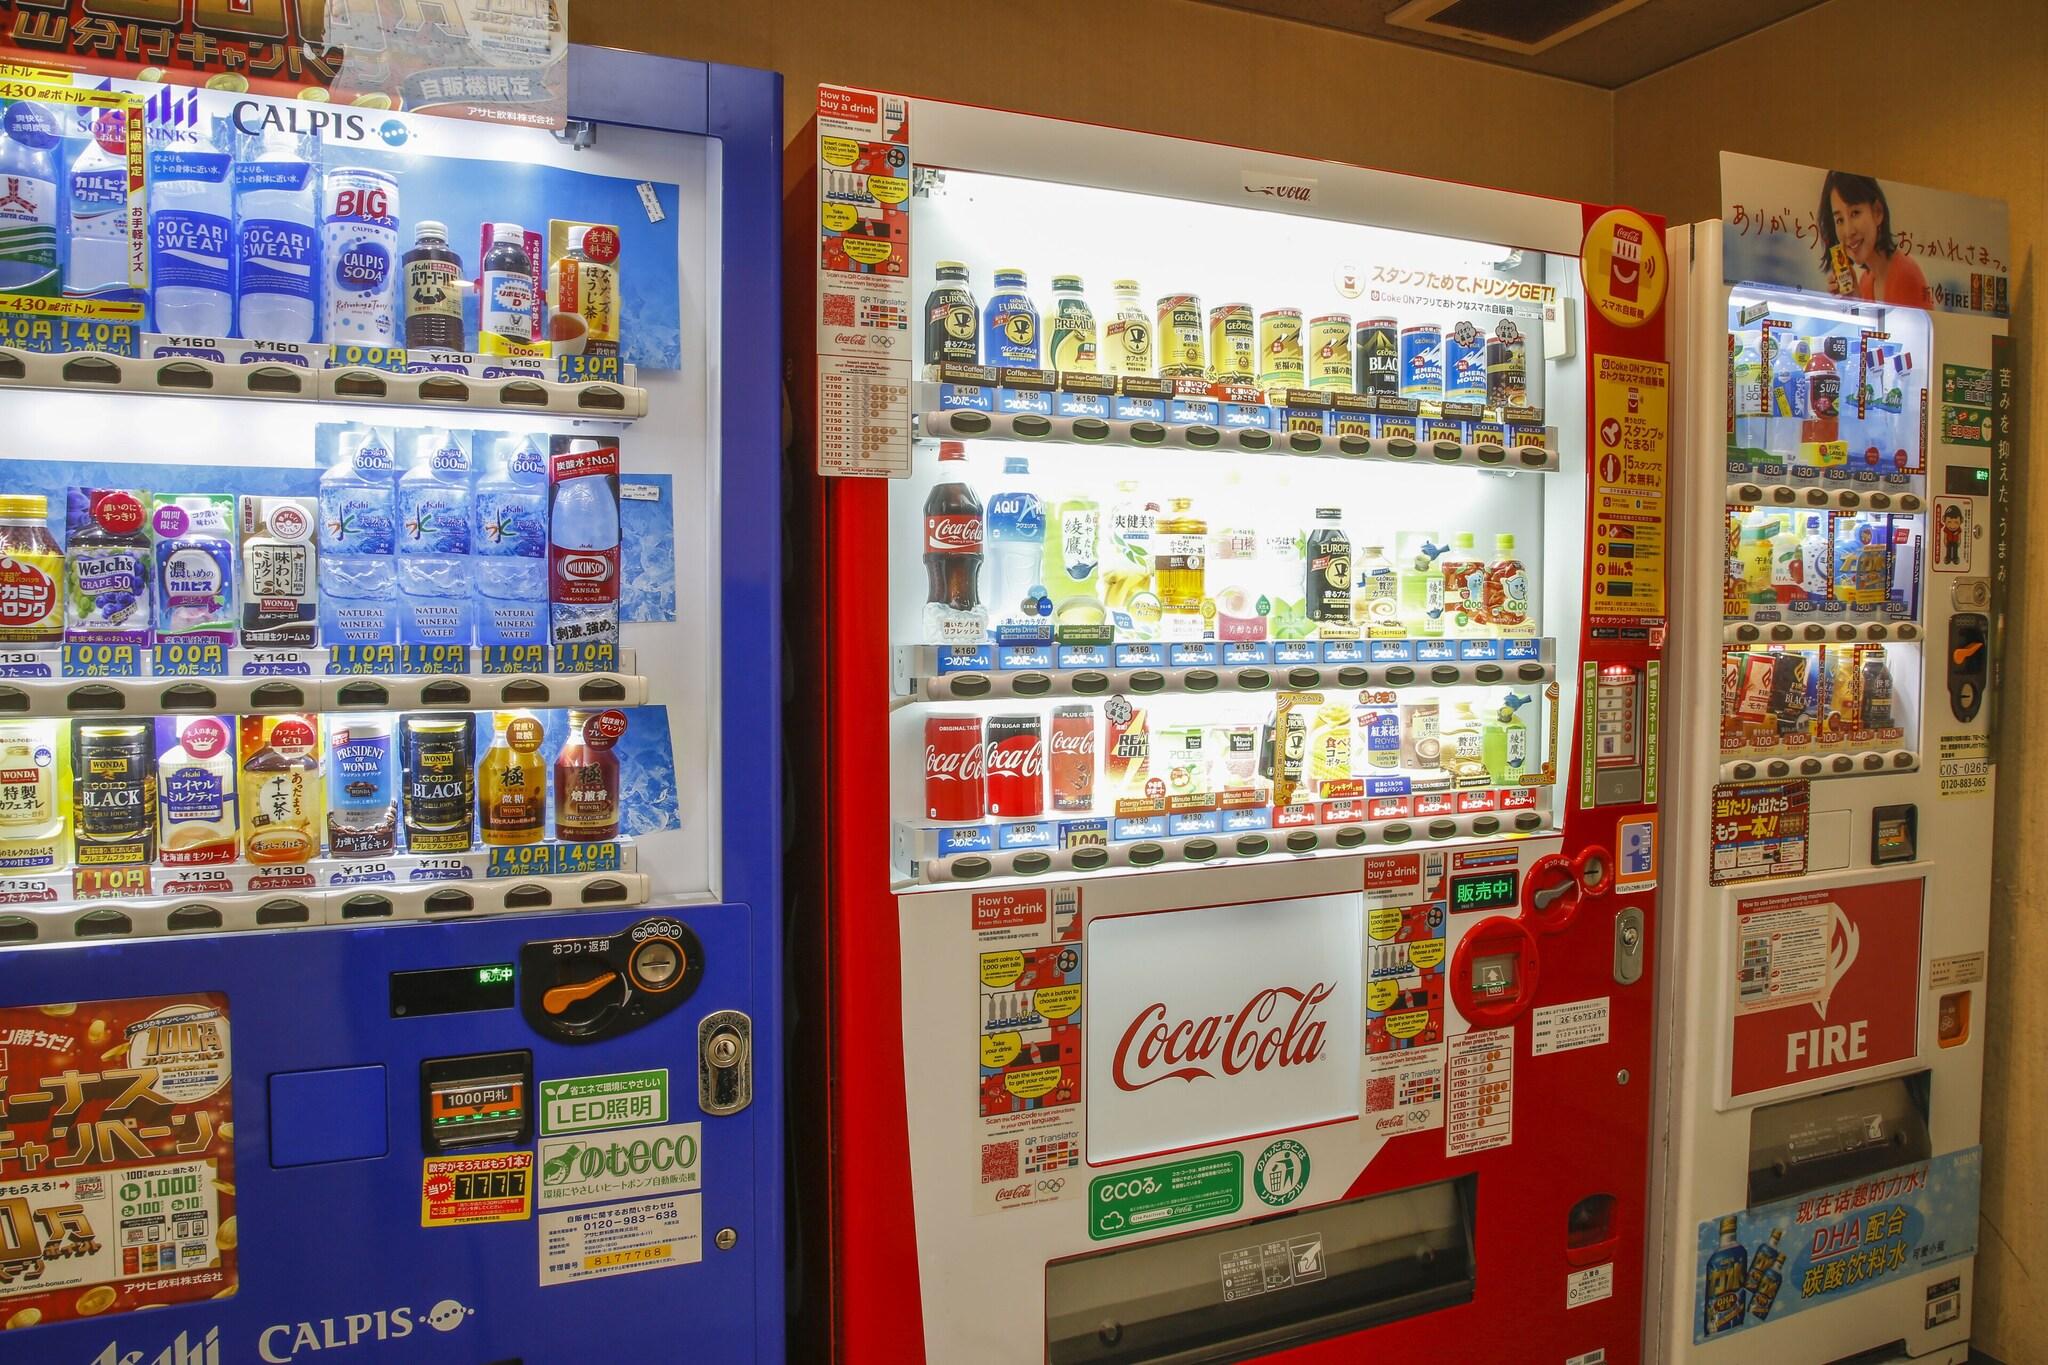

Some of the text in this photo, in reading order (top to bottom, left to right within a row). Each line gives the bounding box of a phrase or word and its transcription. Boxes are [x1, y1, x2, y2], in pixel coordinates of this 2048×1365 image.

[420, 77, 532, 98] 自販機限定
[820, 90, 851, 101] How to
[467, 106, 555, 126] アサヒ飲料株式会社
[820, 99, 876, 116] buy a drink
[233, 100, 364, 141] CALPIS
[130, 117, 143, 176] 自販機限定
[335, 188, 388, 218] BIG
[157, 221, 228, 242] POCARI
[1732, 204, 1820, 250] ありがとう
[131, 206, 144, 272] お手軽サイズ
[157, 234, 224, 253] SWEAT
[242, 230, 310, 248] POCARI
[242, 244, 304, 260] SWEAT
[344, 253, 384, 270] CALPIS
[343, 268, 383, 282] SODA
[1944, 289, 1970, 309] FIRE
[1601, 299, 1645, 320] スマホ自販機
[61, 321, 131, 344] 140円
[834, 333, 868, 346] Coca-Cola
[560, 356, 619, 374] 130円
[935, 519, 983, 540] Coca-Cola
[78, 556, 134, 577] Welch's
[274, 551, 290, 590] 味わい
[566, 563, 605, 576] WILKINSON
[81, 576, 131, 590] GRAPE 50
[170, 582, 213, 592] カルピス
[571, 587, 601, 595] TANSAN
[263, 600, 295, 610] WONDA
[415, 607, 460, 616] NATURAL
[338, 609, 385, 619] NATURAL
[417, 618, 458, 627] MINERAL
[494, 610, 535, 618] NATURAL
[340, 620, 385, 630] MINERAL
[495, 620, 536, 629] MINERAL
[345, 631, 380, 641] WATER
[422, 629, 455, 638] WATER
[500, 631, 532, 639] WATER
[63, 646, 133, 663] 100円
[154, 645, 222, 662] 100円
[253, 653, 299, 662] ¥140
[332, 646, 395, 663] 110円
[403, 645, 464, 662] 110円
[483, 646, 543, 662] 110円
[556, 645, 613, 661] 110円
[283, 737, 302, 747] ゼロ
[336, 745, 386, 760] PRESIDENT
[355, 756, 365, 764] OF
[342, 761, 379, 772] WONDA
[172, 780, 214, 791] ロイヤル
[413, 783, 464, 800] BLACK
[1940, 777, 1987, 790] 0120-883-065
[3, 785, 37, 801] 特製
[82, 789, 142, 808] BLACK
[168, 791, 220, 804] ミルクティー
[270, 775, 292, 821] 十六茶
[291, 771, 304, 817] あったまる
[502, 793, 525, 805] 微糖
[1717, 789, 1733, 797] KIRIN
[1716, 796, 1789, 818] 当たりが出たら
[491, 846, 550, 864] 140円
[559, 843, 616, 861] 140円
[1457, 879, 1510, 903] 販売中
[978, 894, 1014, 906] How to
[978, 902, 1043, 921] buy a drink
[646, 925, 657, 933] 100
[552, 940, 611, 955] おつり・返却
[1113, 981, 1337, 1092] Coca-Cola
[1785, 1019, 1868, 1074] FIRE
[570, 1077, 661, 1097] 省エネで環境にやさしい
[448, 1089, 509, 1107] 1000円札
[555, 1094, 653, 1125] LED照明
[580, 1134, 698, 1179] のむeco
[543, 1172, 697, 1199] 環境にやさしいヒートポンプ自動販売機
[567, 1201, 675, 1224] 自販機に関するお問い合わせは
[1811, 1206, 1909, 1257] DHA 配合
[1800, 1241, 1909, 1299] 碳酸饮料水
[124, 1271, 224, 1294] アサヒ飲料株式会社
[259, 1306, 415, 1364] CALPIS
